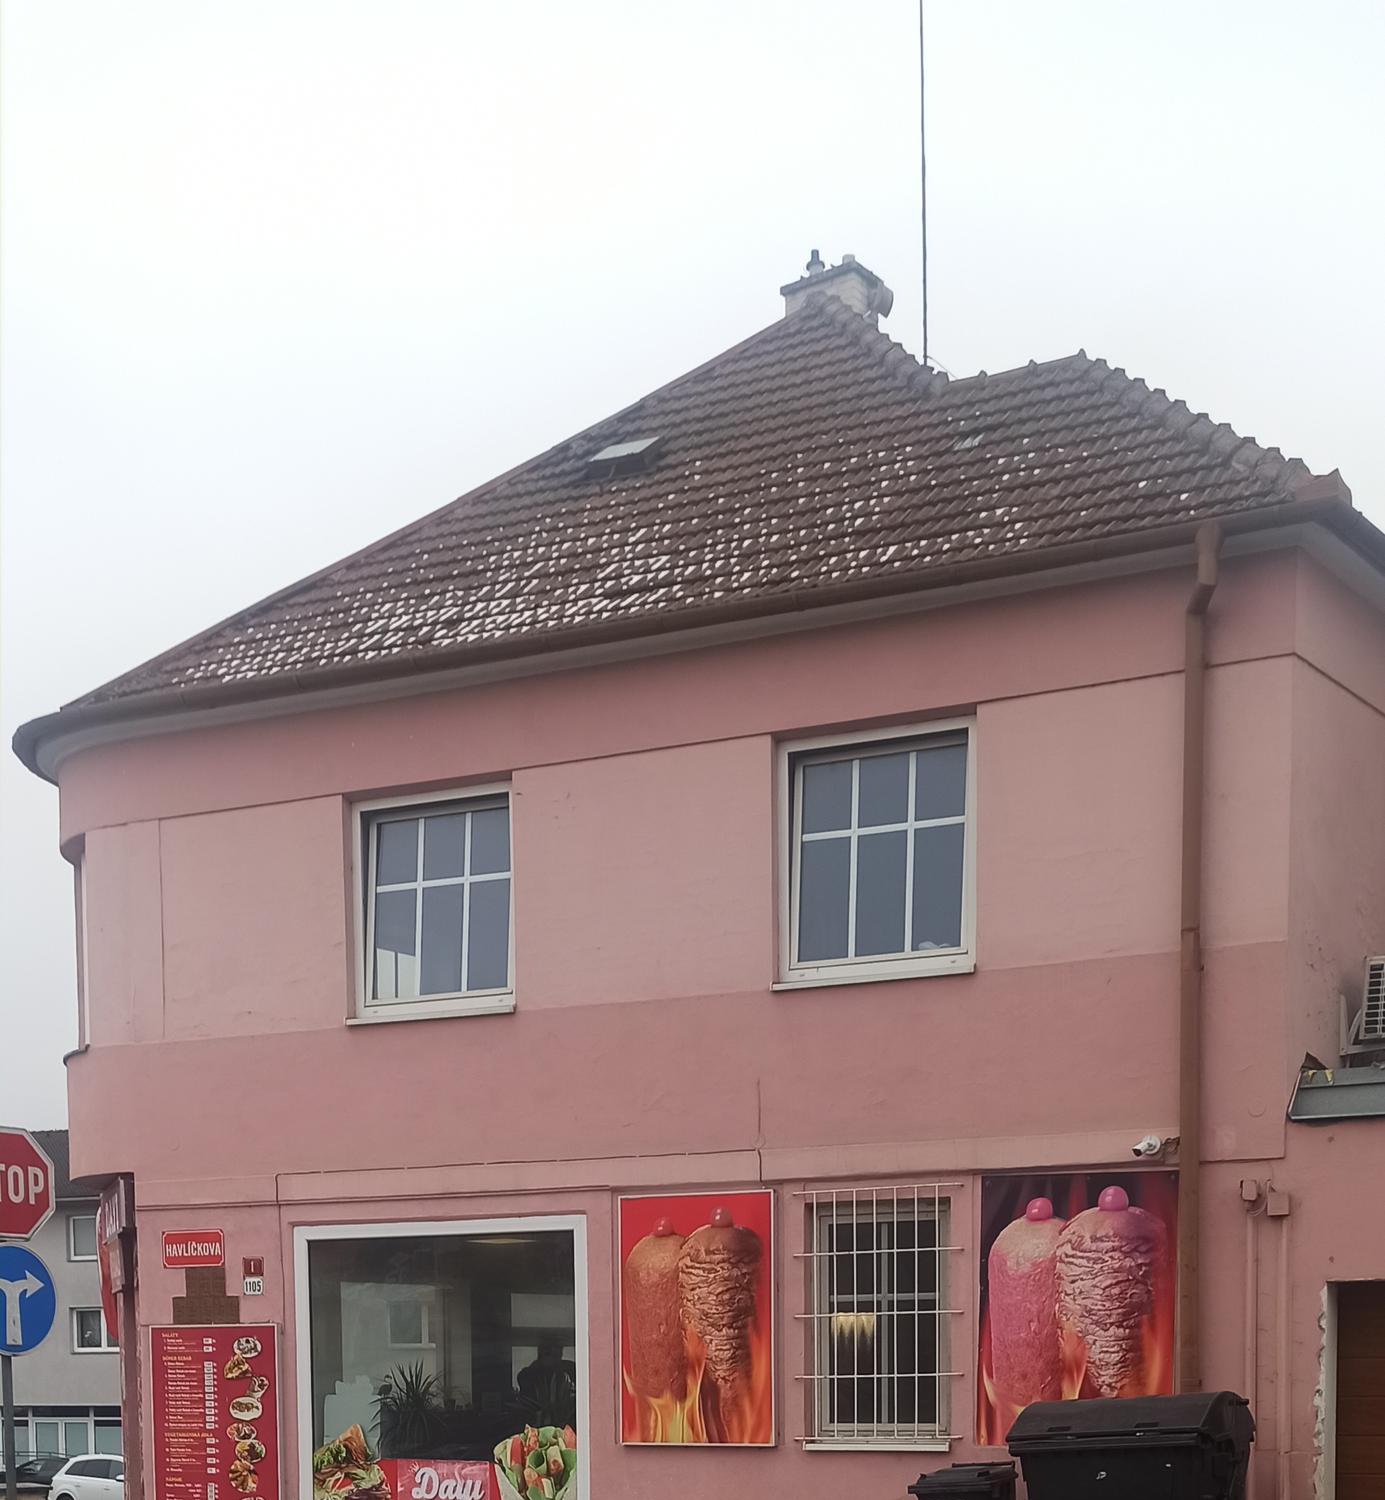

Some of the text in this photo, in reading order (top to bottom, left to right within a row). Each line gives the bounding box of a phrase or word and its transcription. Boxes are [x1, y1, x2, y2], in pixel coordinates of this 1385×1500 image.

[166, 1241, 221, 1257] HAVLÍČKOVA
[250, 1260, 254, 1273] 1
[245, 1280, 262, 1292] 1105
